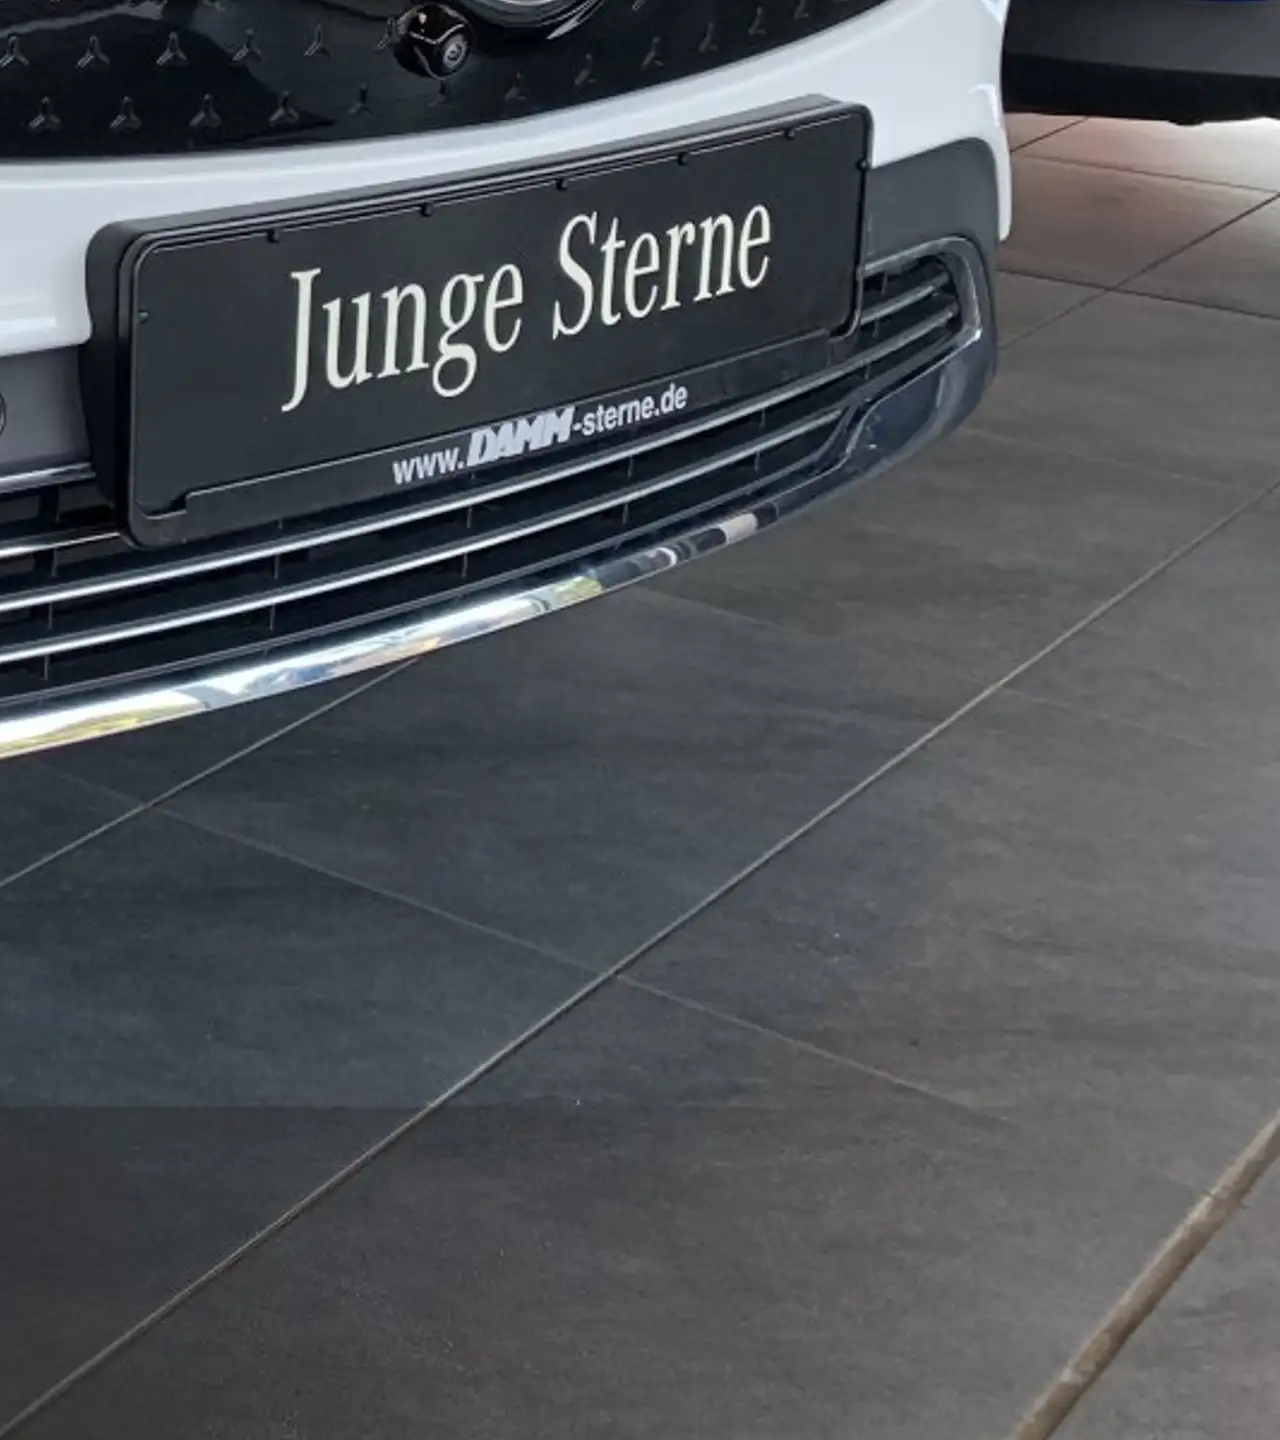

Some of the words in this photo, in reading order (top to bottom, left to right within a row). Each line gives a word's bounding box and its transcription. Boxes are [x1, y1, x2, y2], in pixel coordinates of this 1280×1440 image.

[281, 263, 524, 412] Junge
[552, 203, 772, 340] Sterne
[392, 382, 688, 486] www.DAMM-sterne.de
